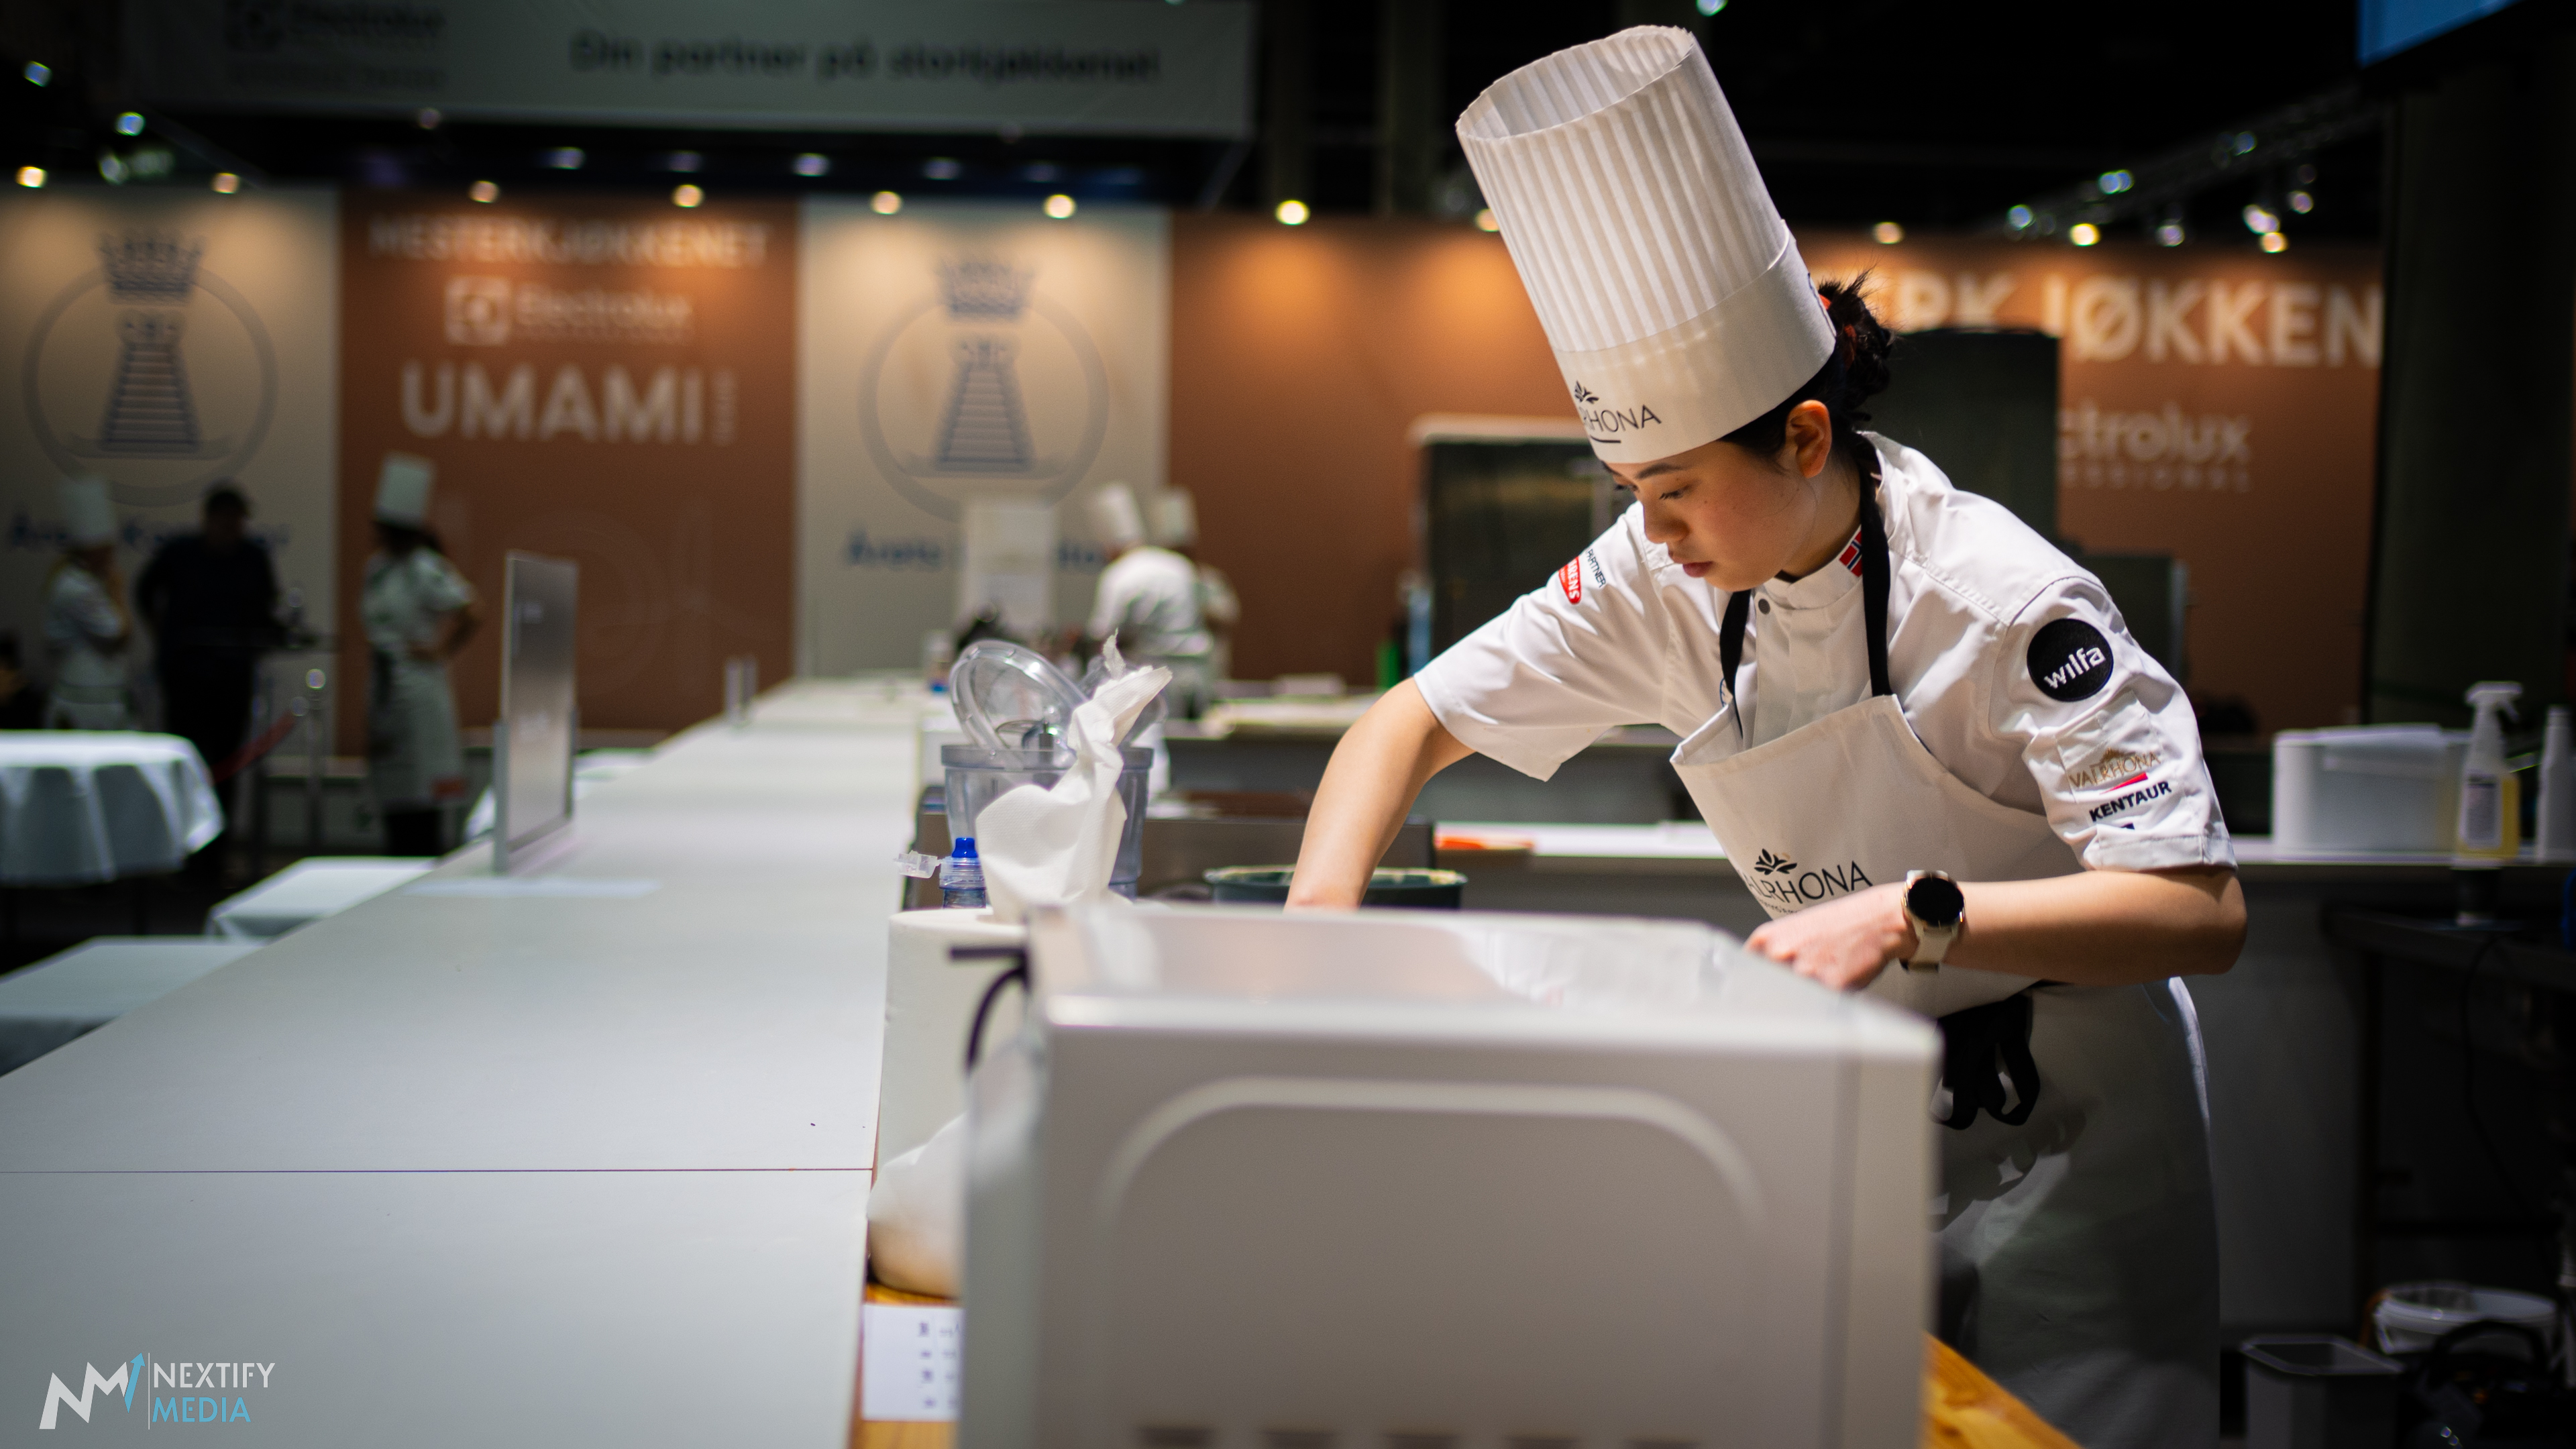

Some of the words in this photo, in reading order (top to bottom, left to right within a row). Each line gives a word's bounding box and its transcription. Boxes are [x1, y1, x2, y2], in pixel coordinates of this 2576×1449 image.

[402, 360, 706, 445] UMAMI
[2044, 647, 2106, 689] wilfa
[2089, 781, 2172, 822] KENTAUR
